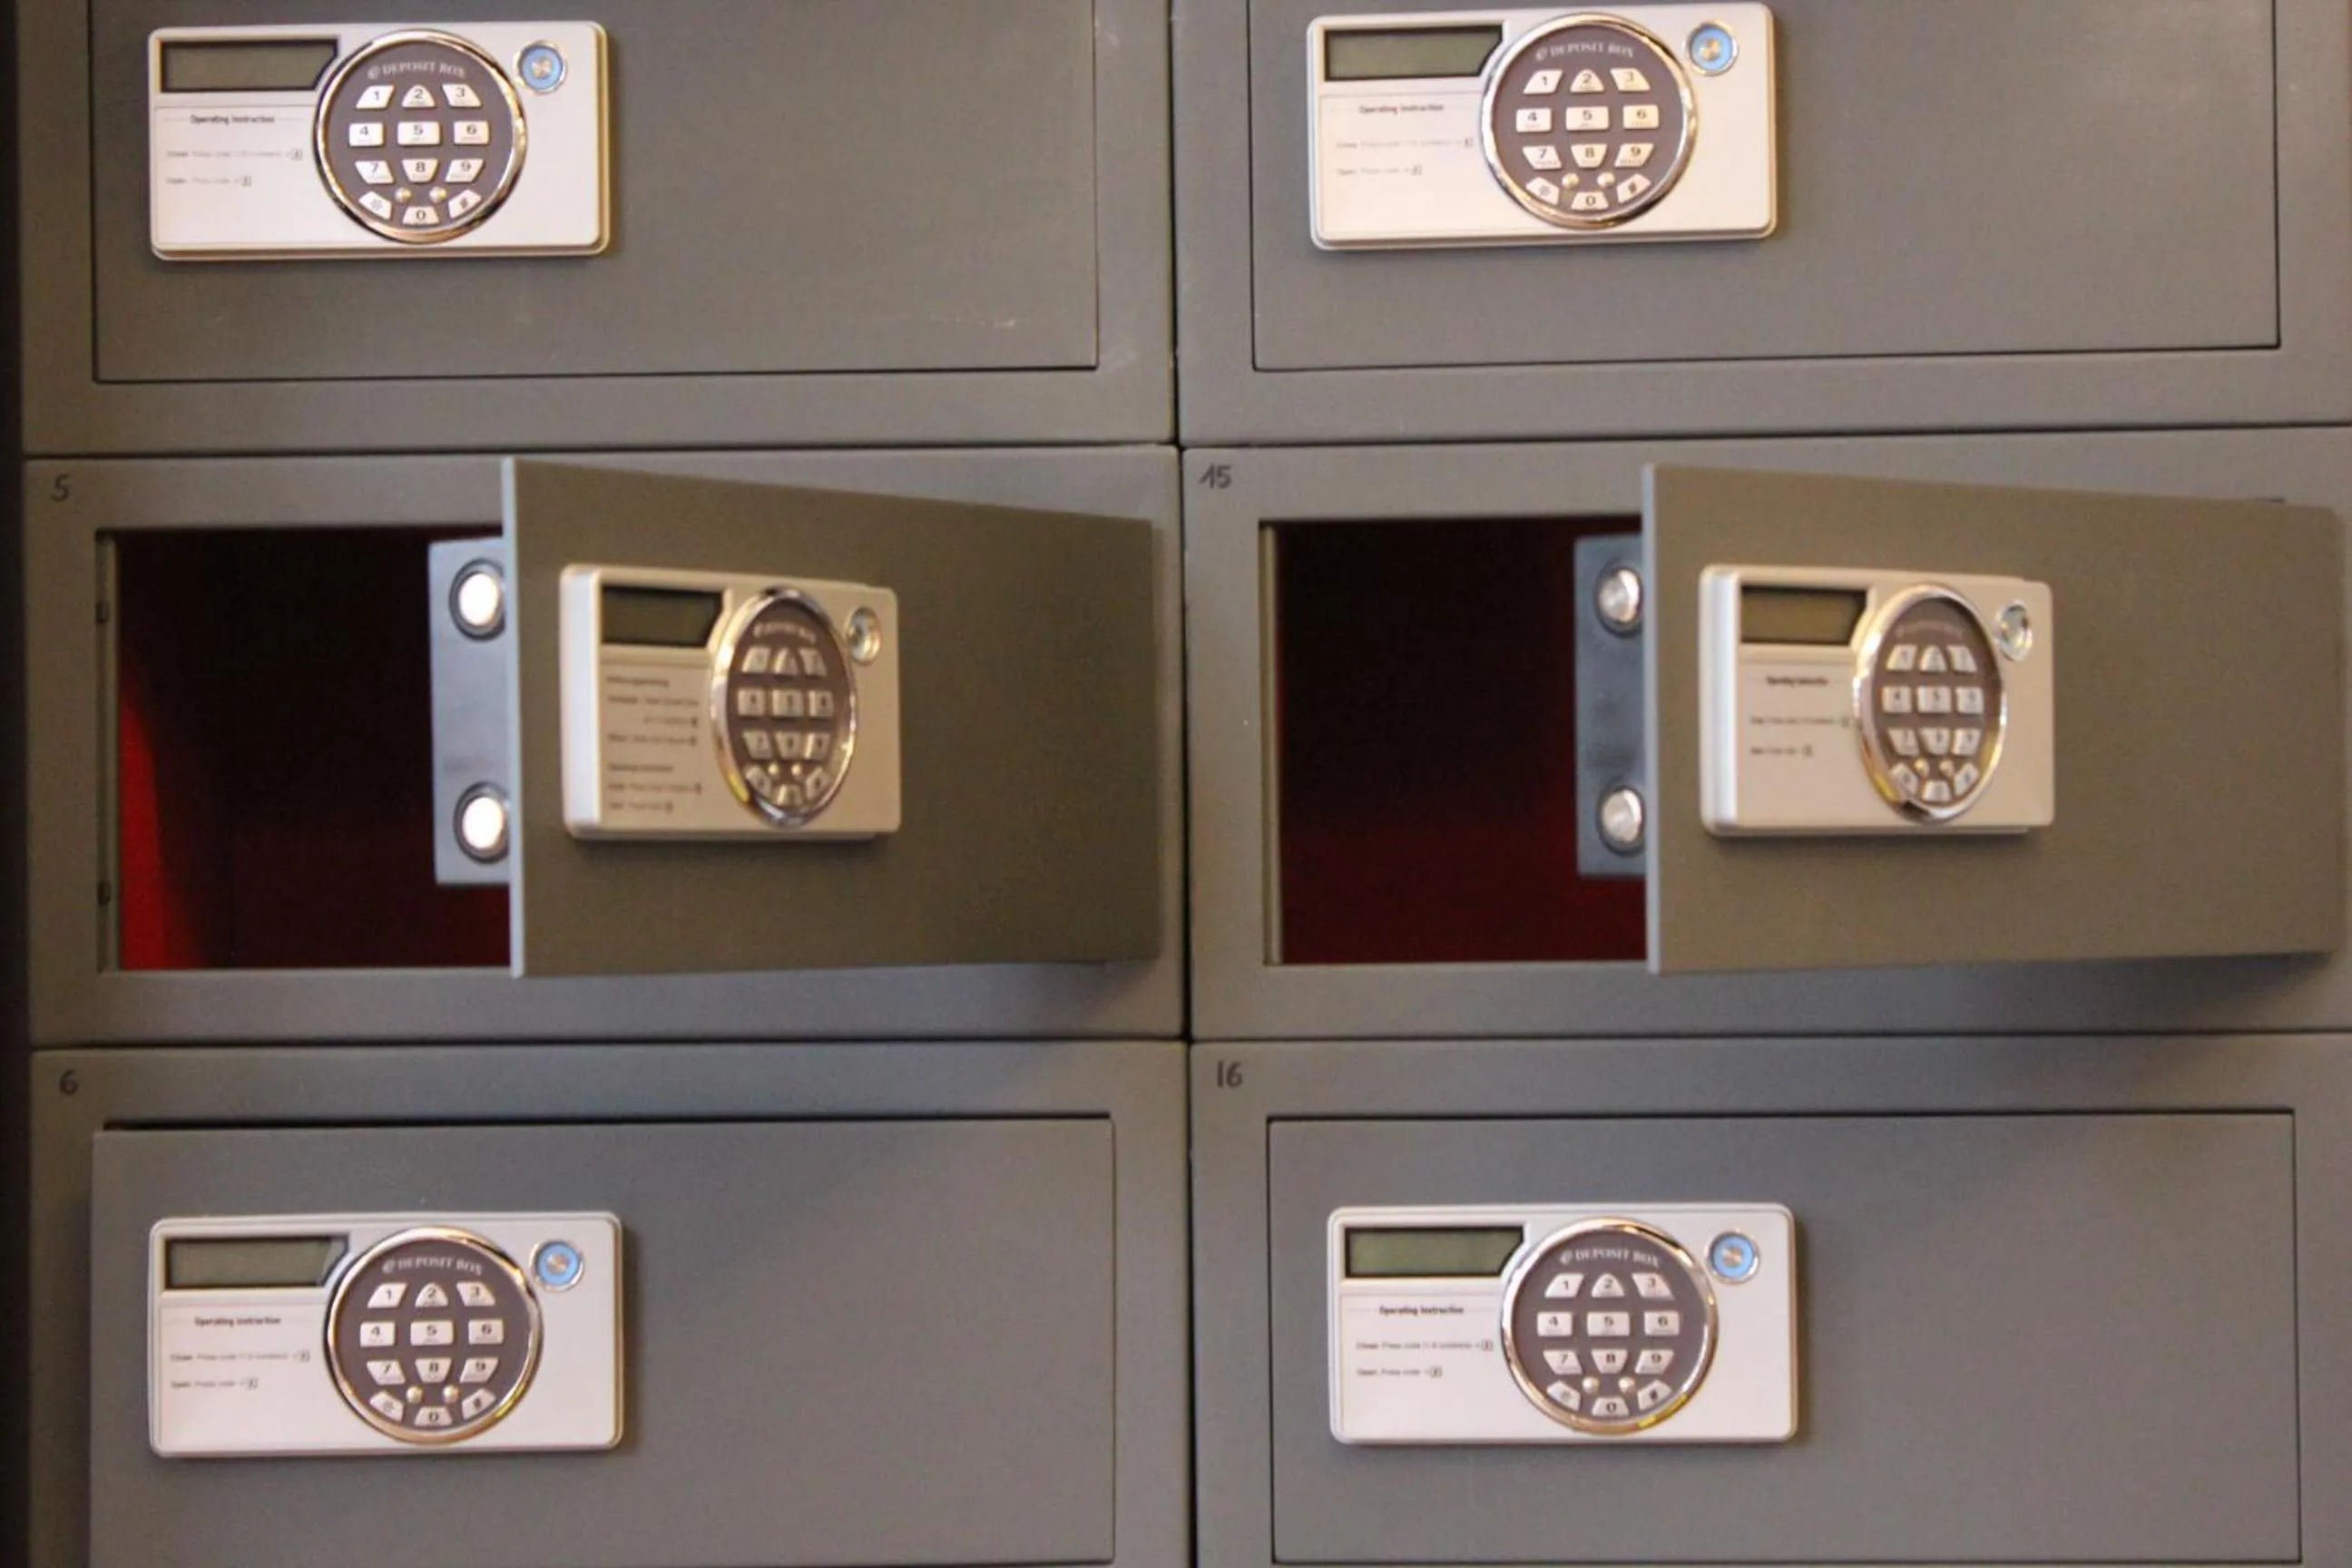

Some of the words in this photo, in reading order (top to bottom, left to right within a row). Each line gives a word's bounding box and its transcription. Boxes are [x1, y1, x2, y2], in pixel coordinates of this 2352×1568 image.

[50, 473, 70, 503] 5
[1198, 462, 1232, 490] 15
[59, 1069, 79, 1096] 6
[1217, 1060, 1243, 1088] 16
